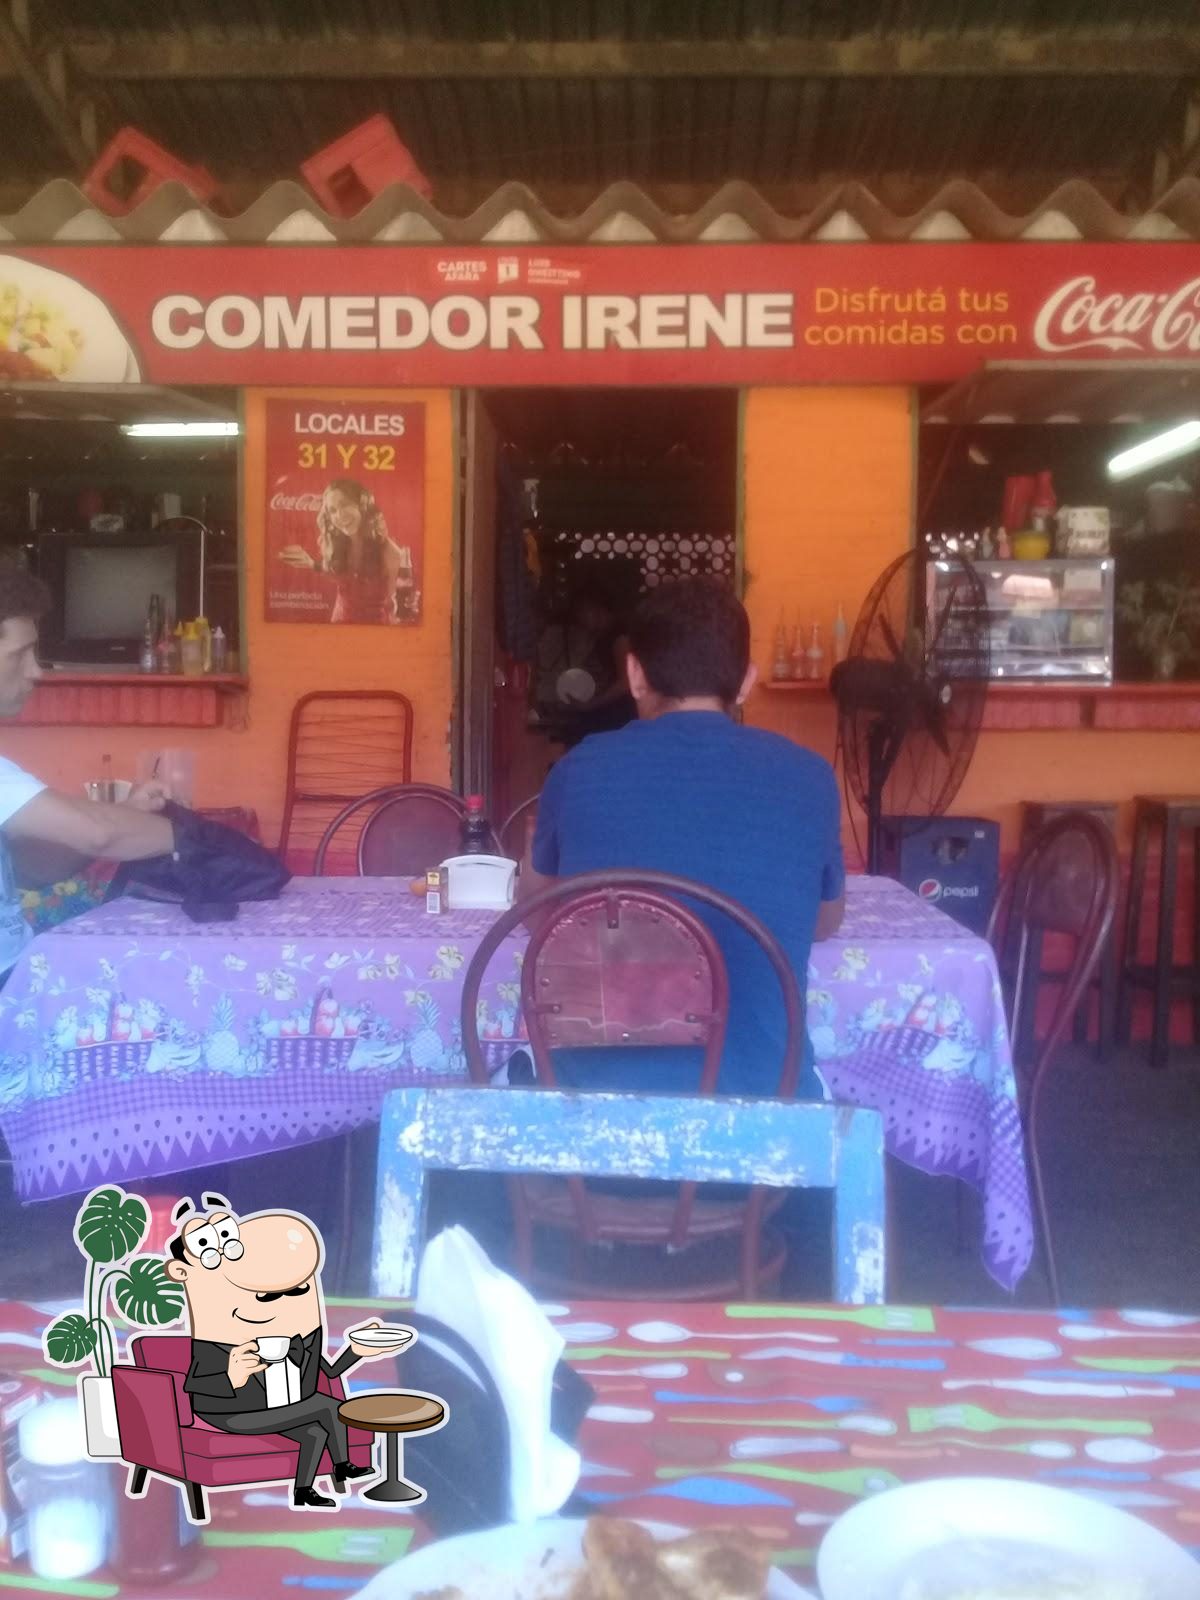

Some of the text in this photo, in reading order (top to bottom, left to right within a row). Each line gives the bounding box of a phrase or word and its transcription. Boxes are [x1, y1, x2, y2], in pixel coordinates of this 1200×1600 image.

[815, 286, 1009, 313] Disfrutá tus
[151, 293, 793, 350] COMEDOR IRENE
[804, 320, 1018, 346] comidas con
[294, 412, 405, 436] LOCALES
[298, 442, 396, 471] 31 Y 32
